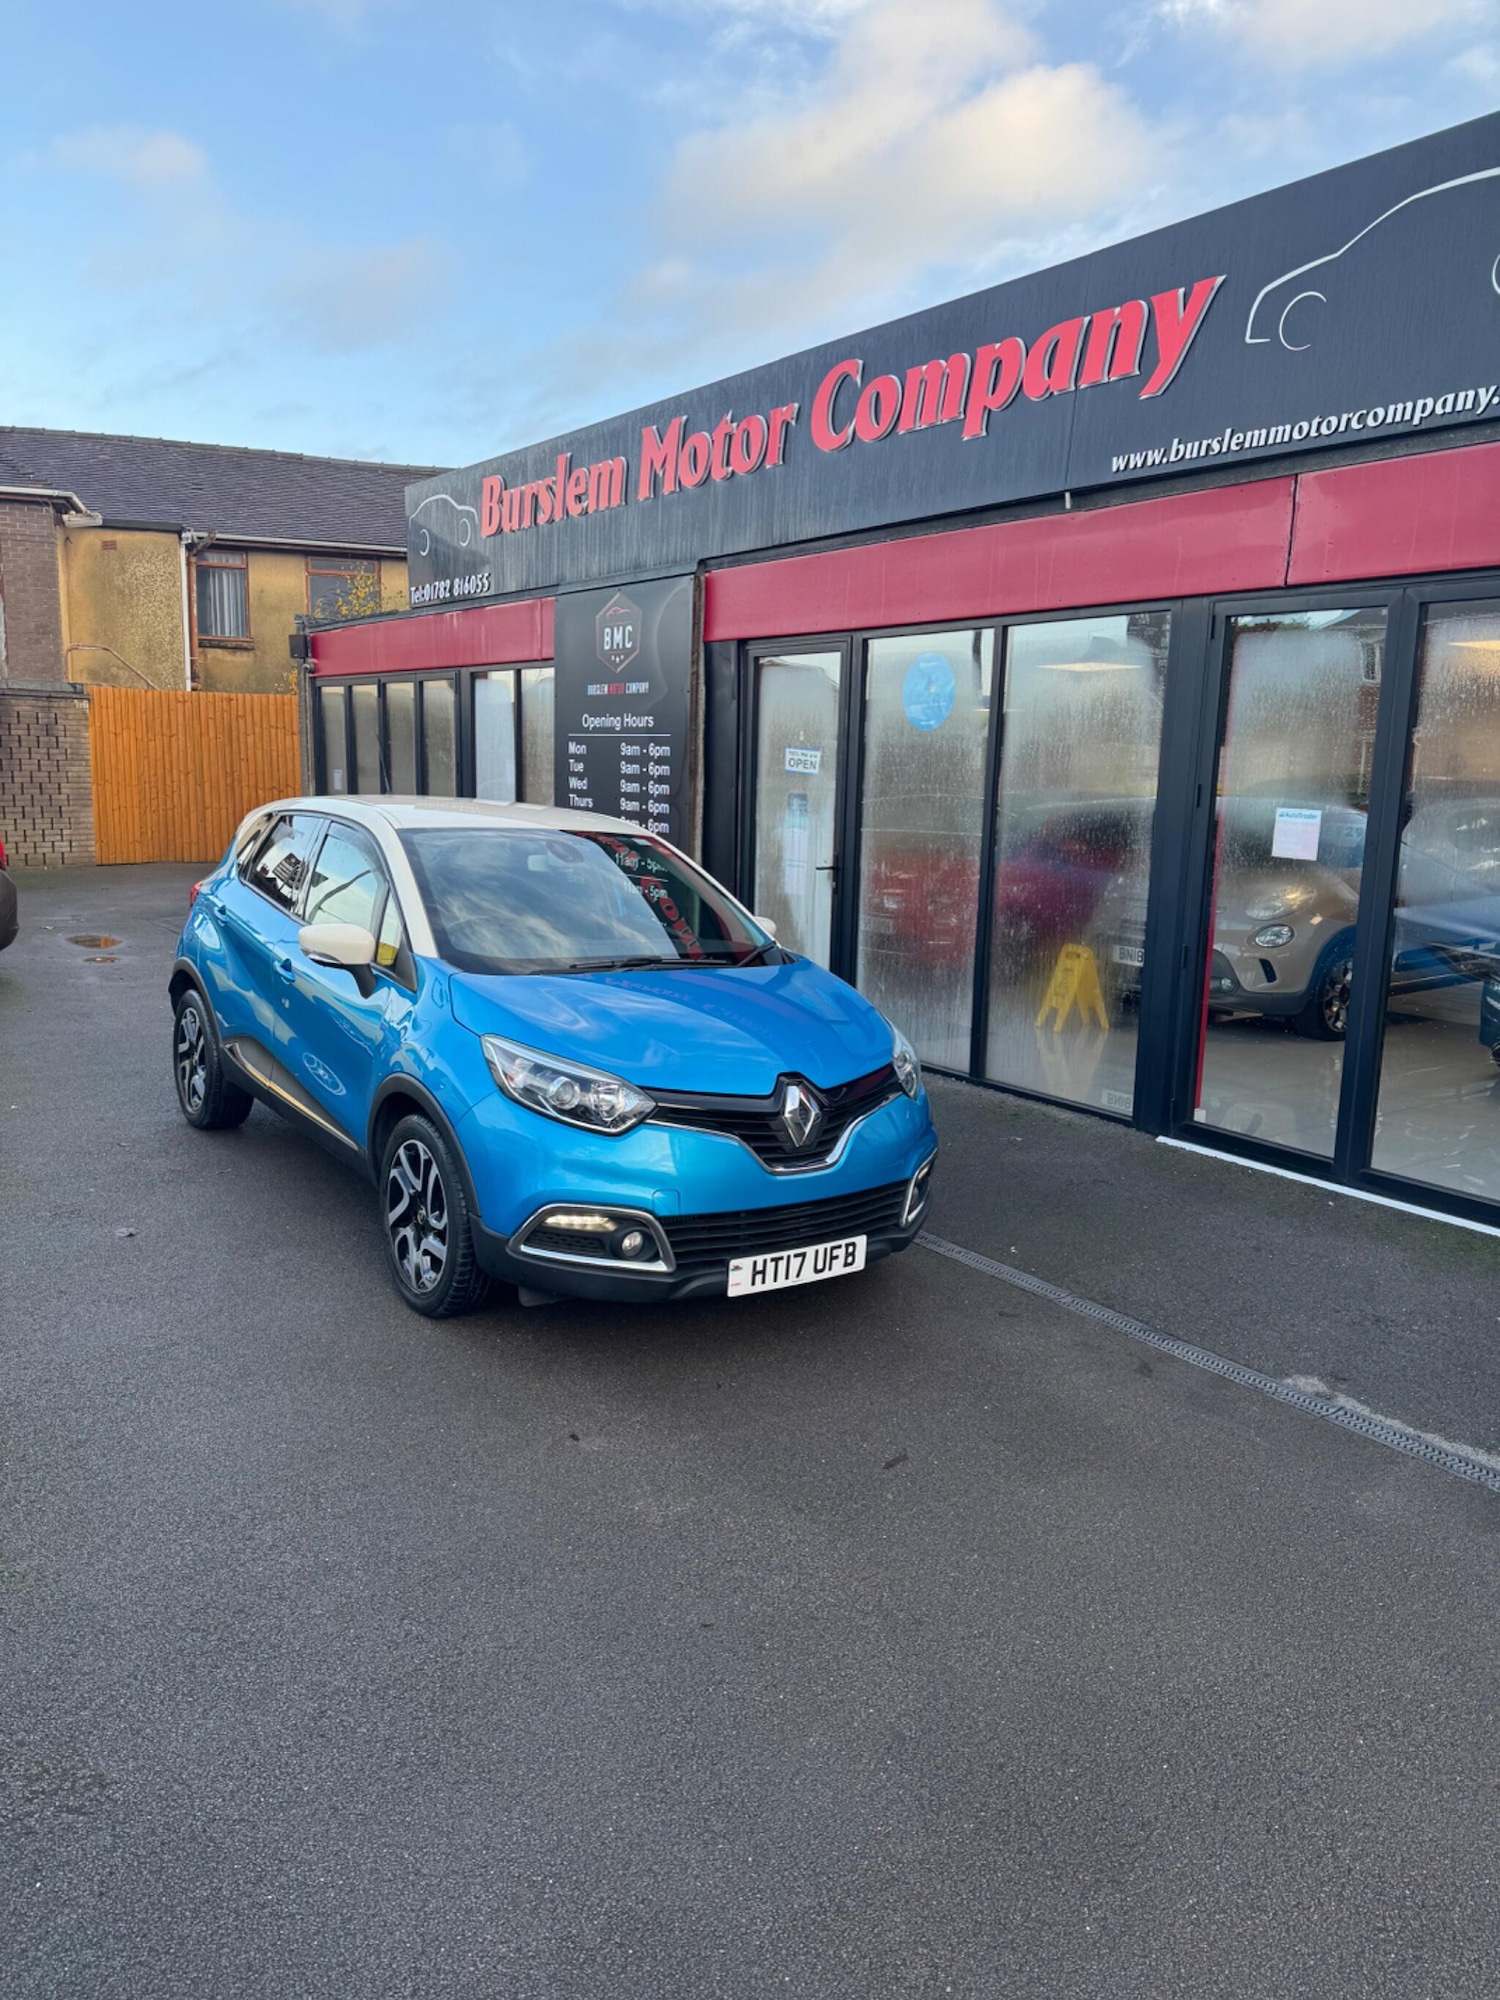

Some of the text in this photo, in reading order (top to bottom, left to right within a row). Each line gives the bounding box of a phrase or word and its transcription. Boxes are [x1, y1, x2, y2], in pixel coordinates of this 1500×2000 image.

[481, 274, 1227, 538] Burslem Motor Company
[1112, 384, 1500, 473] www.burslemmotorcompany.
[410, 572, 492, 604] Tel:01782 816055
[604, 625, 633, 650] BMC
[582, 713, 654, 731] Opening Hours
[568, 741, 587, 755] Mon
[620, 742, 641, 756] 9am
[648, 742, 671, 759] 6pm
[568, 759, 584, 772] Tue
[620, 760, 641, 774] 9am
[648, 761, 671, 778] 6pm
[788, 757, 817, 770] OPEN
[568, 776, 588, 790] Wed
[620, 779, 641, 793] 9am
[648, 780, 670, 798] 6pm
[568, 794, 594, 808] Thurs
[620, 797, 640, 811] 9am
[647, 799, 670, 816] 6pm
[647, 818, 670, 834] 6pm
[751, 1241, 857, 1287] HT17 UFB
